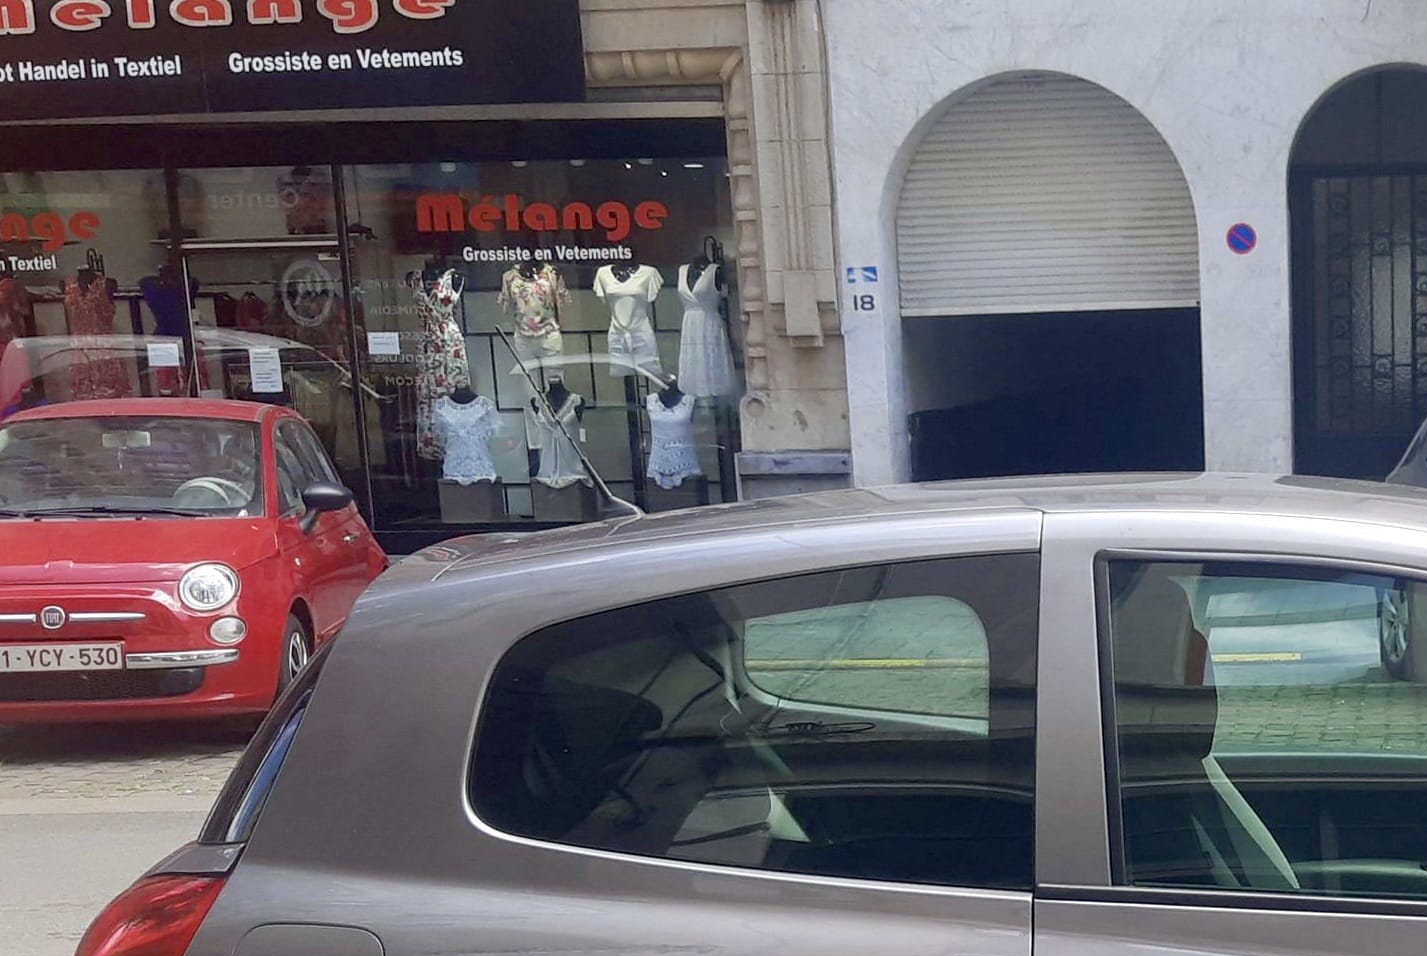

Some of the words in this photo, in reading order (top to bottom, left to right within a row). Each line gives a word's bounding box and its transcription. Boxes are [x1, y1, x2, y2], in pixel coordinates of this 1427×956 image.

[18, 58, 86, 81] Handel
[90, 58, 109, 78] in
[113, 55, 182, 77] Textiel
[228, 51, 322, 73] Grossiste
[327, 53, 352, 69] en
[356, 47, 464, 69] Vetements
[462, 246, 530, 262] Grossiste
[534, 248, 552, 260] en
[555, 245, 633, 261] Vetements
[8, 254, 57, 271] Textiel
[853, 294, 876, 311] 18
